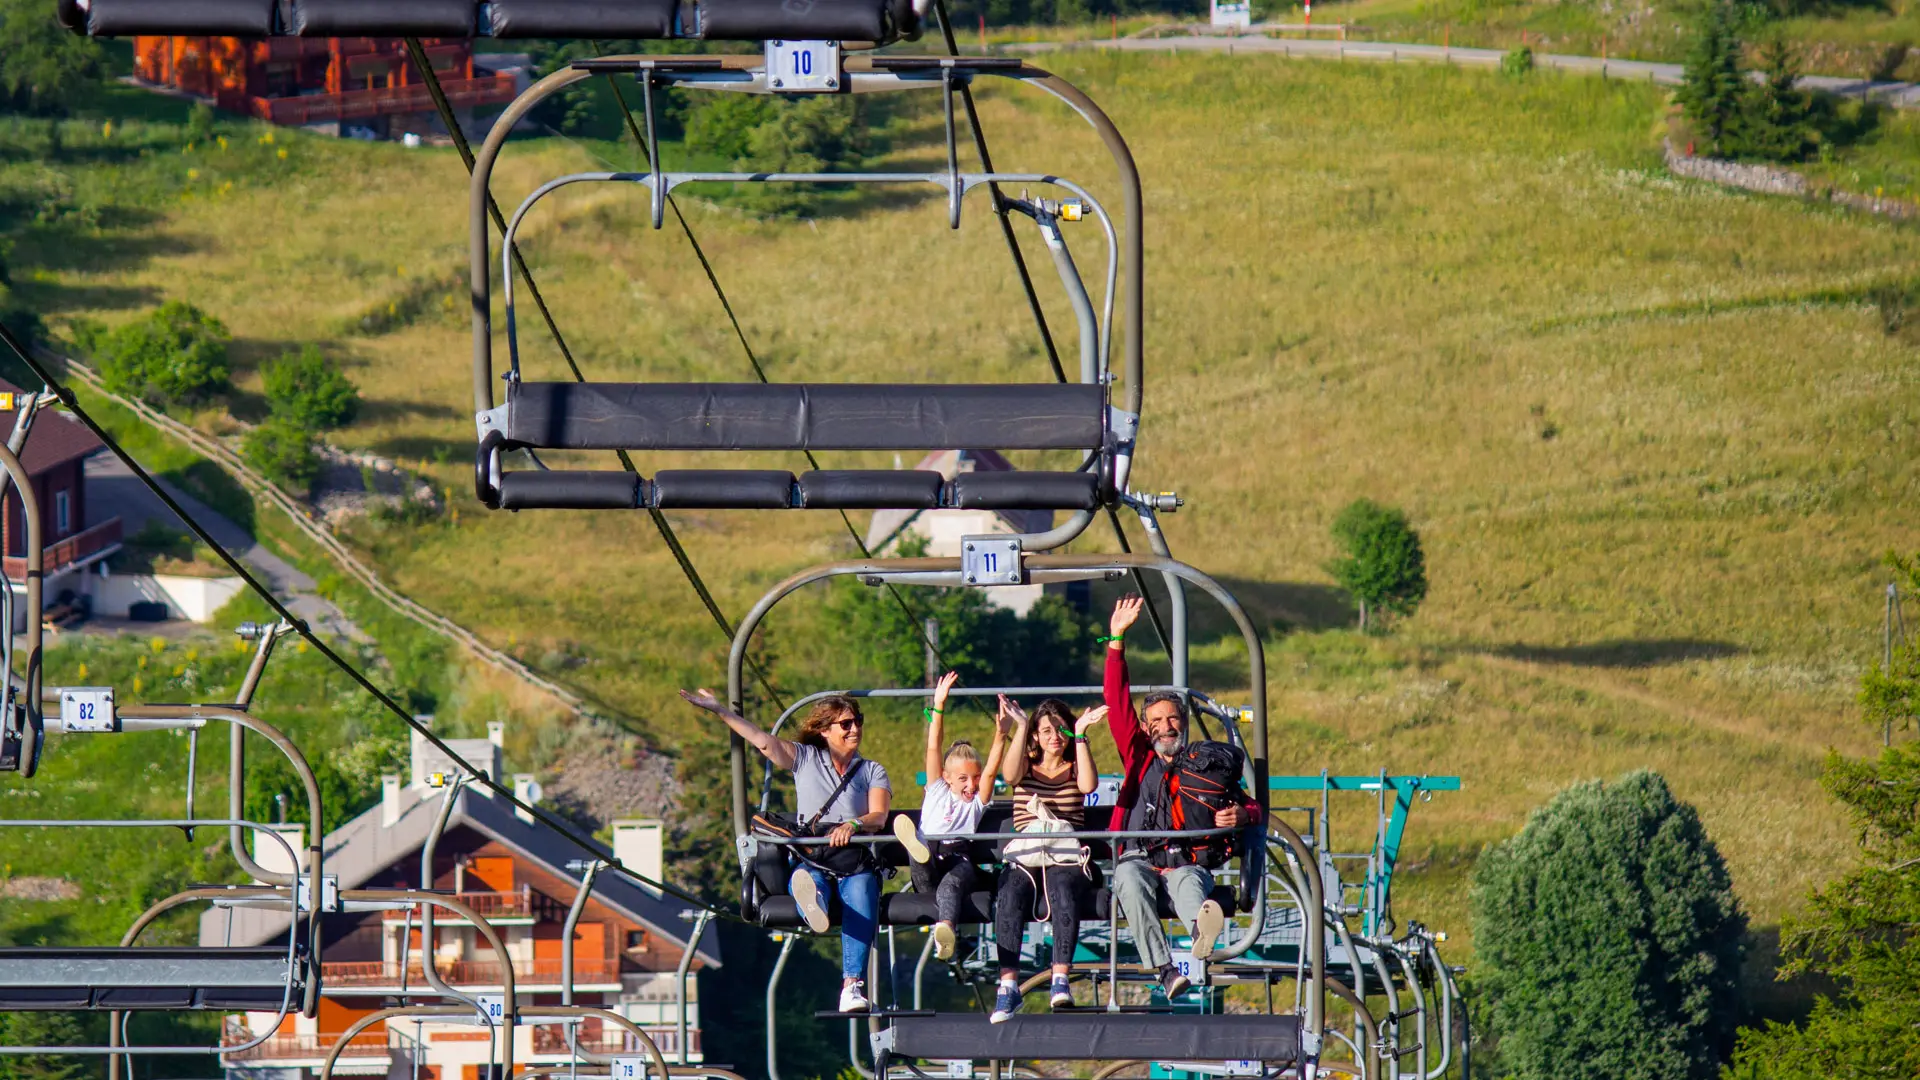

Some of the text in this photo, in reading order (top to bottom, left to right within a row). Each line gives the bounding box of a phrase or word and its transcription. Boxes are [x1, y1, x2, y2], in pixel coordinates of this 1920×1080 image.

[792, 50, 811, 74] 10
[983, 553, 996, 572] 11
[80, 703, 94, 719] 82
[1087, 793, 1099, 806] 12
[1178, 962, 1189, 976] 13
[490, 1004, 501, 1016] 80
[624, 1065, 633, 1076] 79
